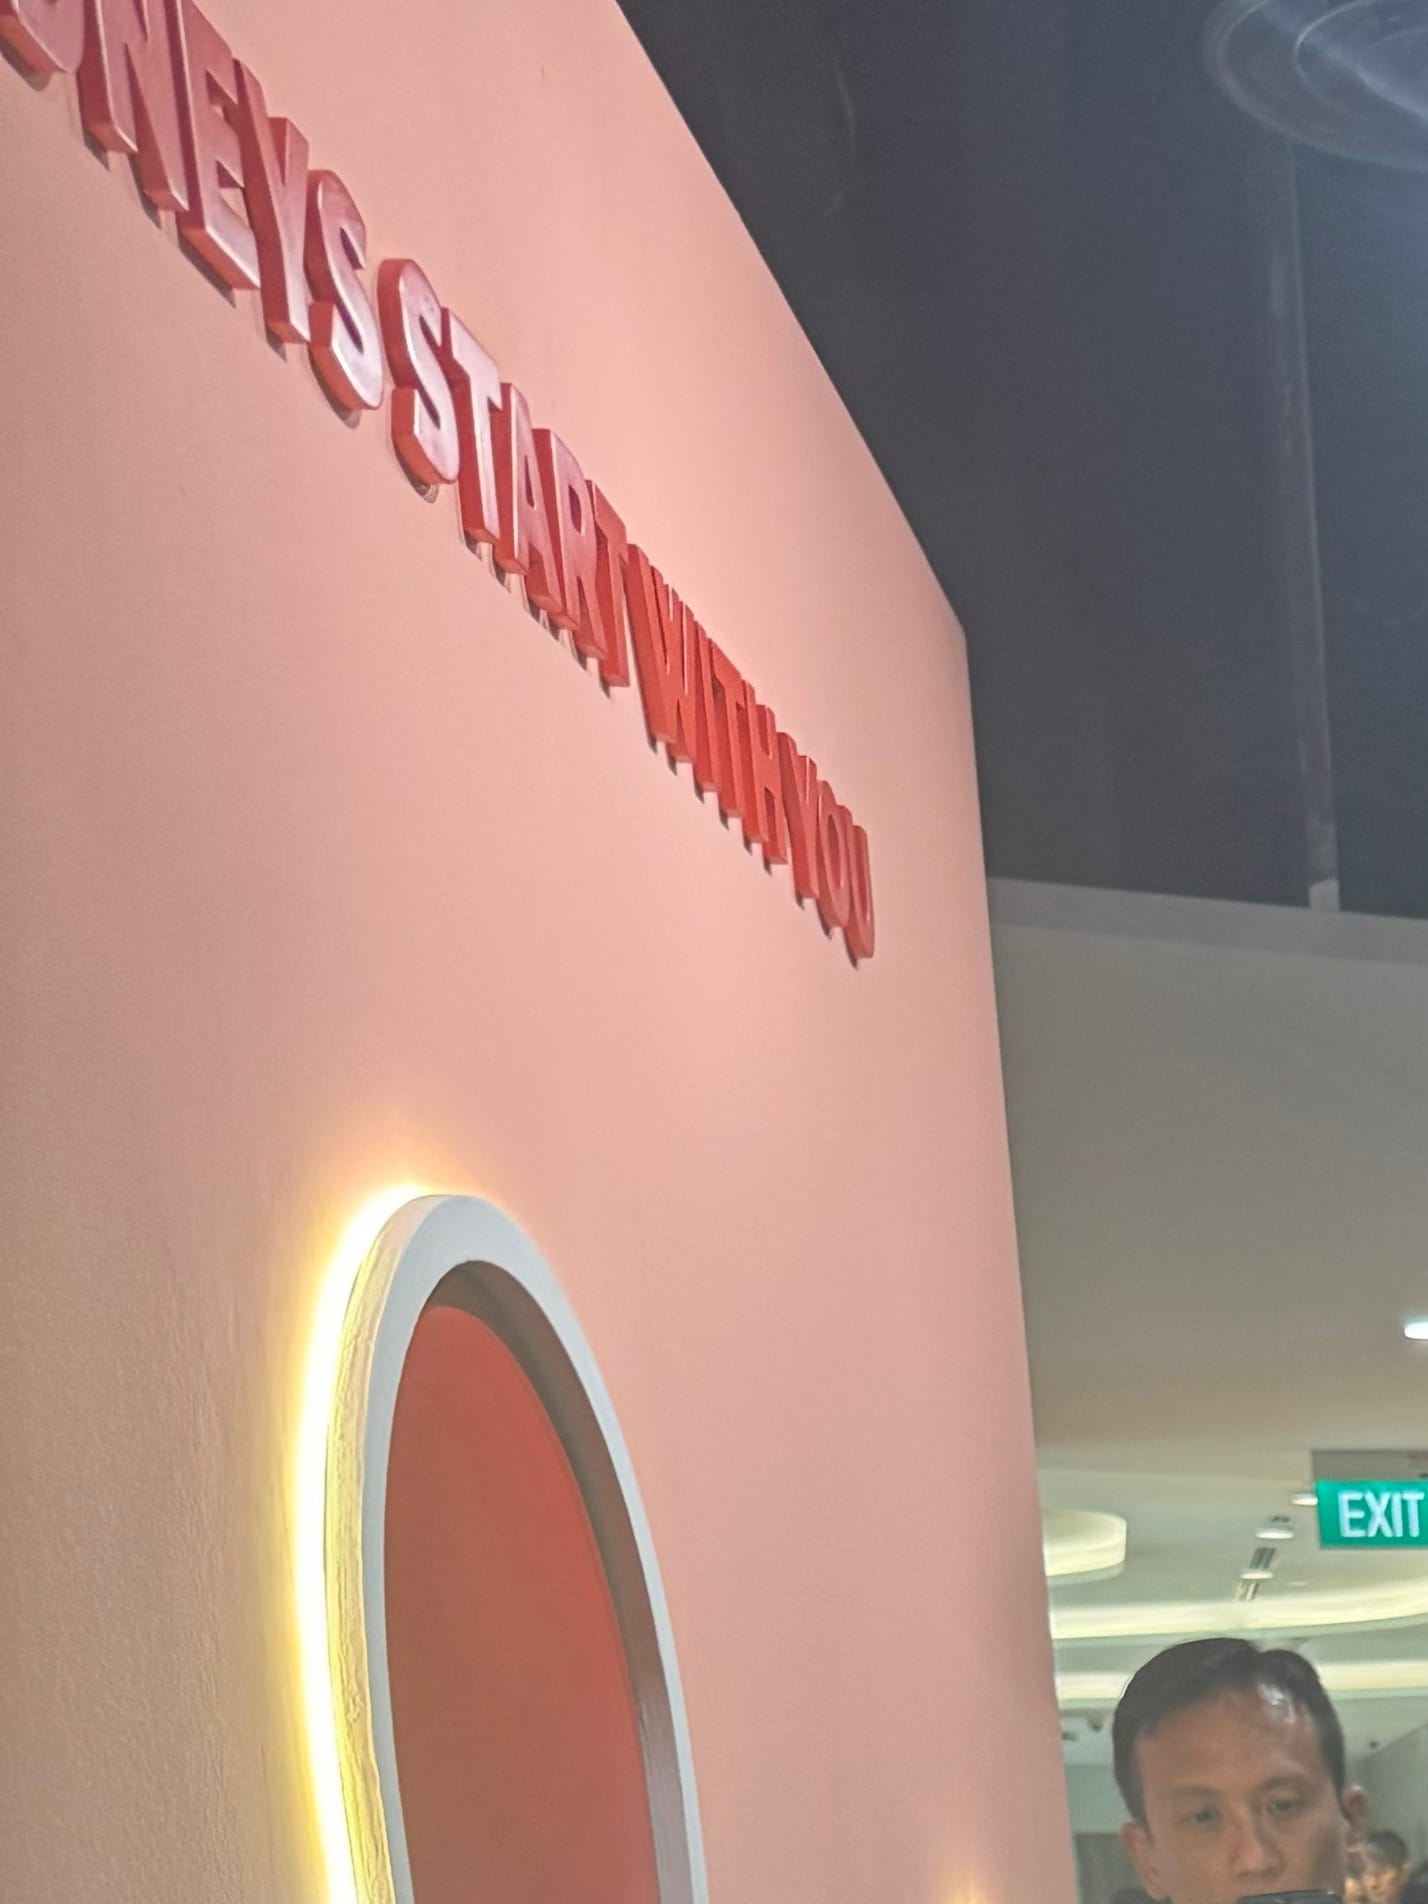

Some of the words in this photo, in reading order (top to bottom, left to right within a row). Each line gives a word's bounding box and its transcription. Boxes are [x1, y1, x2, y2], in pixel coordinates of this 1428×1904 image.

[377, 258, 632, 688] START
[624, 541, 788, 865] WITH
[776, 731, 874, 959] YOU
[1338, 1489, 1425, 1538] EXIT
